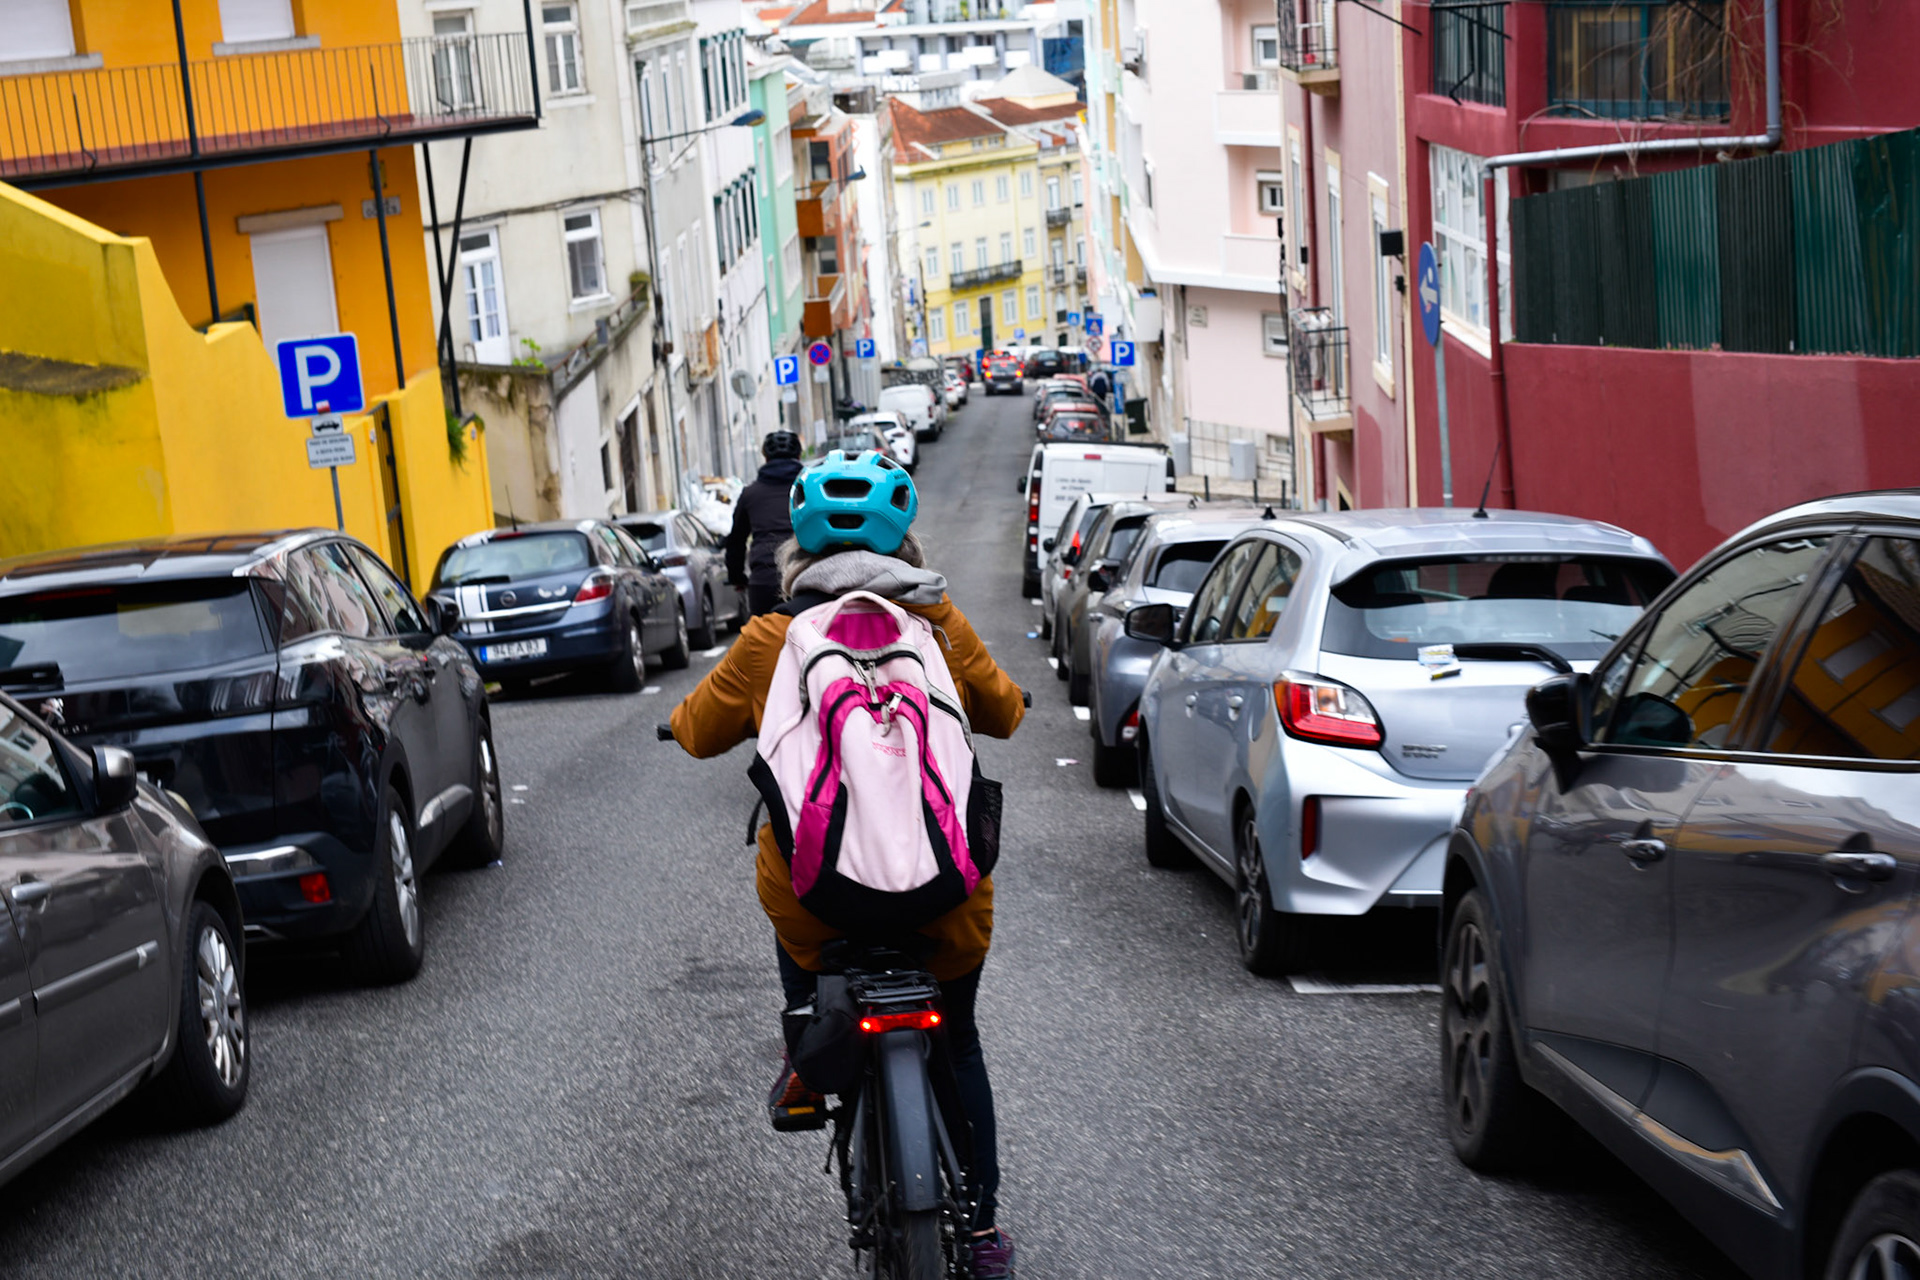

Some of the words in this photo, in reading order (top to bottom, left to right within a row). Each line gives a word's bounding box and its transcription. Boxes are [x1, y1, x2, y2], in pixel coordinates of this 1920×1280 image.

[859, 339, 872, 357] P
[1115, 343, 1130, 365] P
[294, 344, 341, 410] P
[778, 357, 795, 384] P
